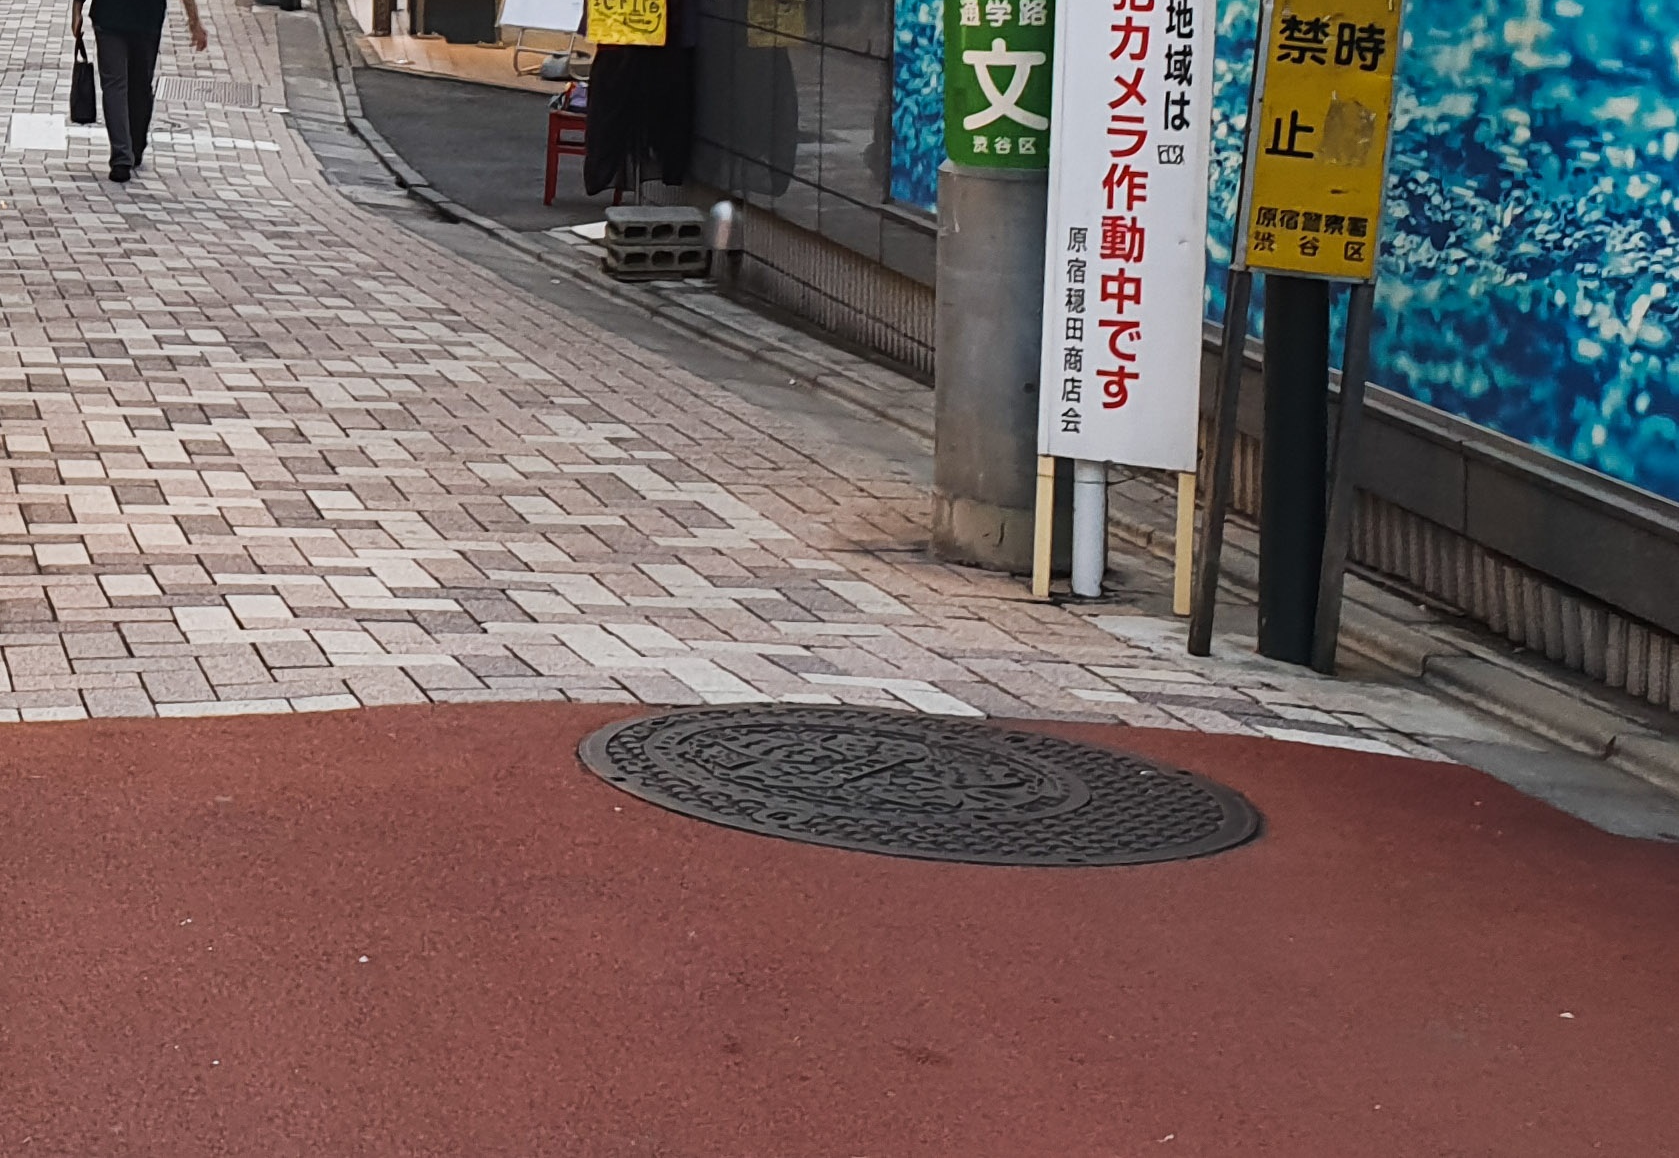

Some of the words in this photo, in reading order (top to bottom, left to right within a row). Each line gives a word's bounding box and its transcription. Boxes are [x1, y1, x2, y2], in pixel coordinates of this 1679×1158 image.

[962, 37, 1050, 131] 文
[1253, 230, 1367, 263] 渋谷区
[1255, 206, 1369, 238] 原宿警察署
[1061, 226, 1089, 434] 原宿穏田商店会
